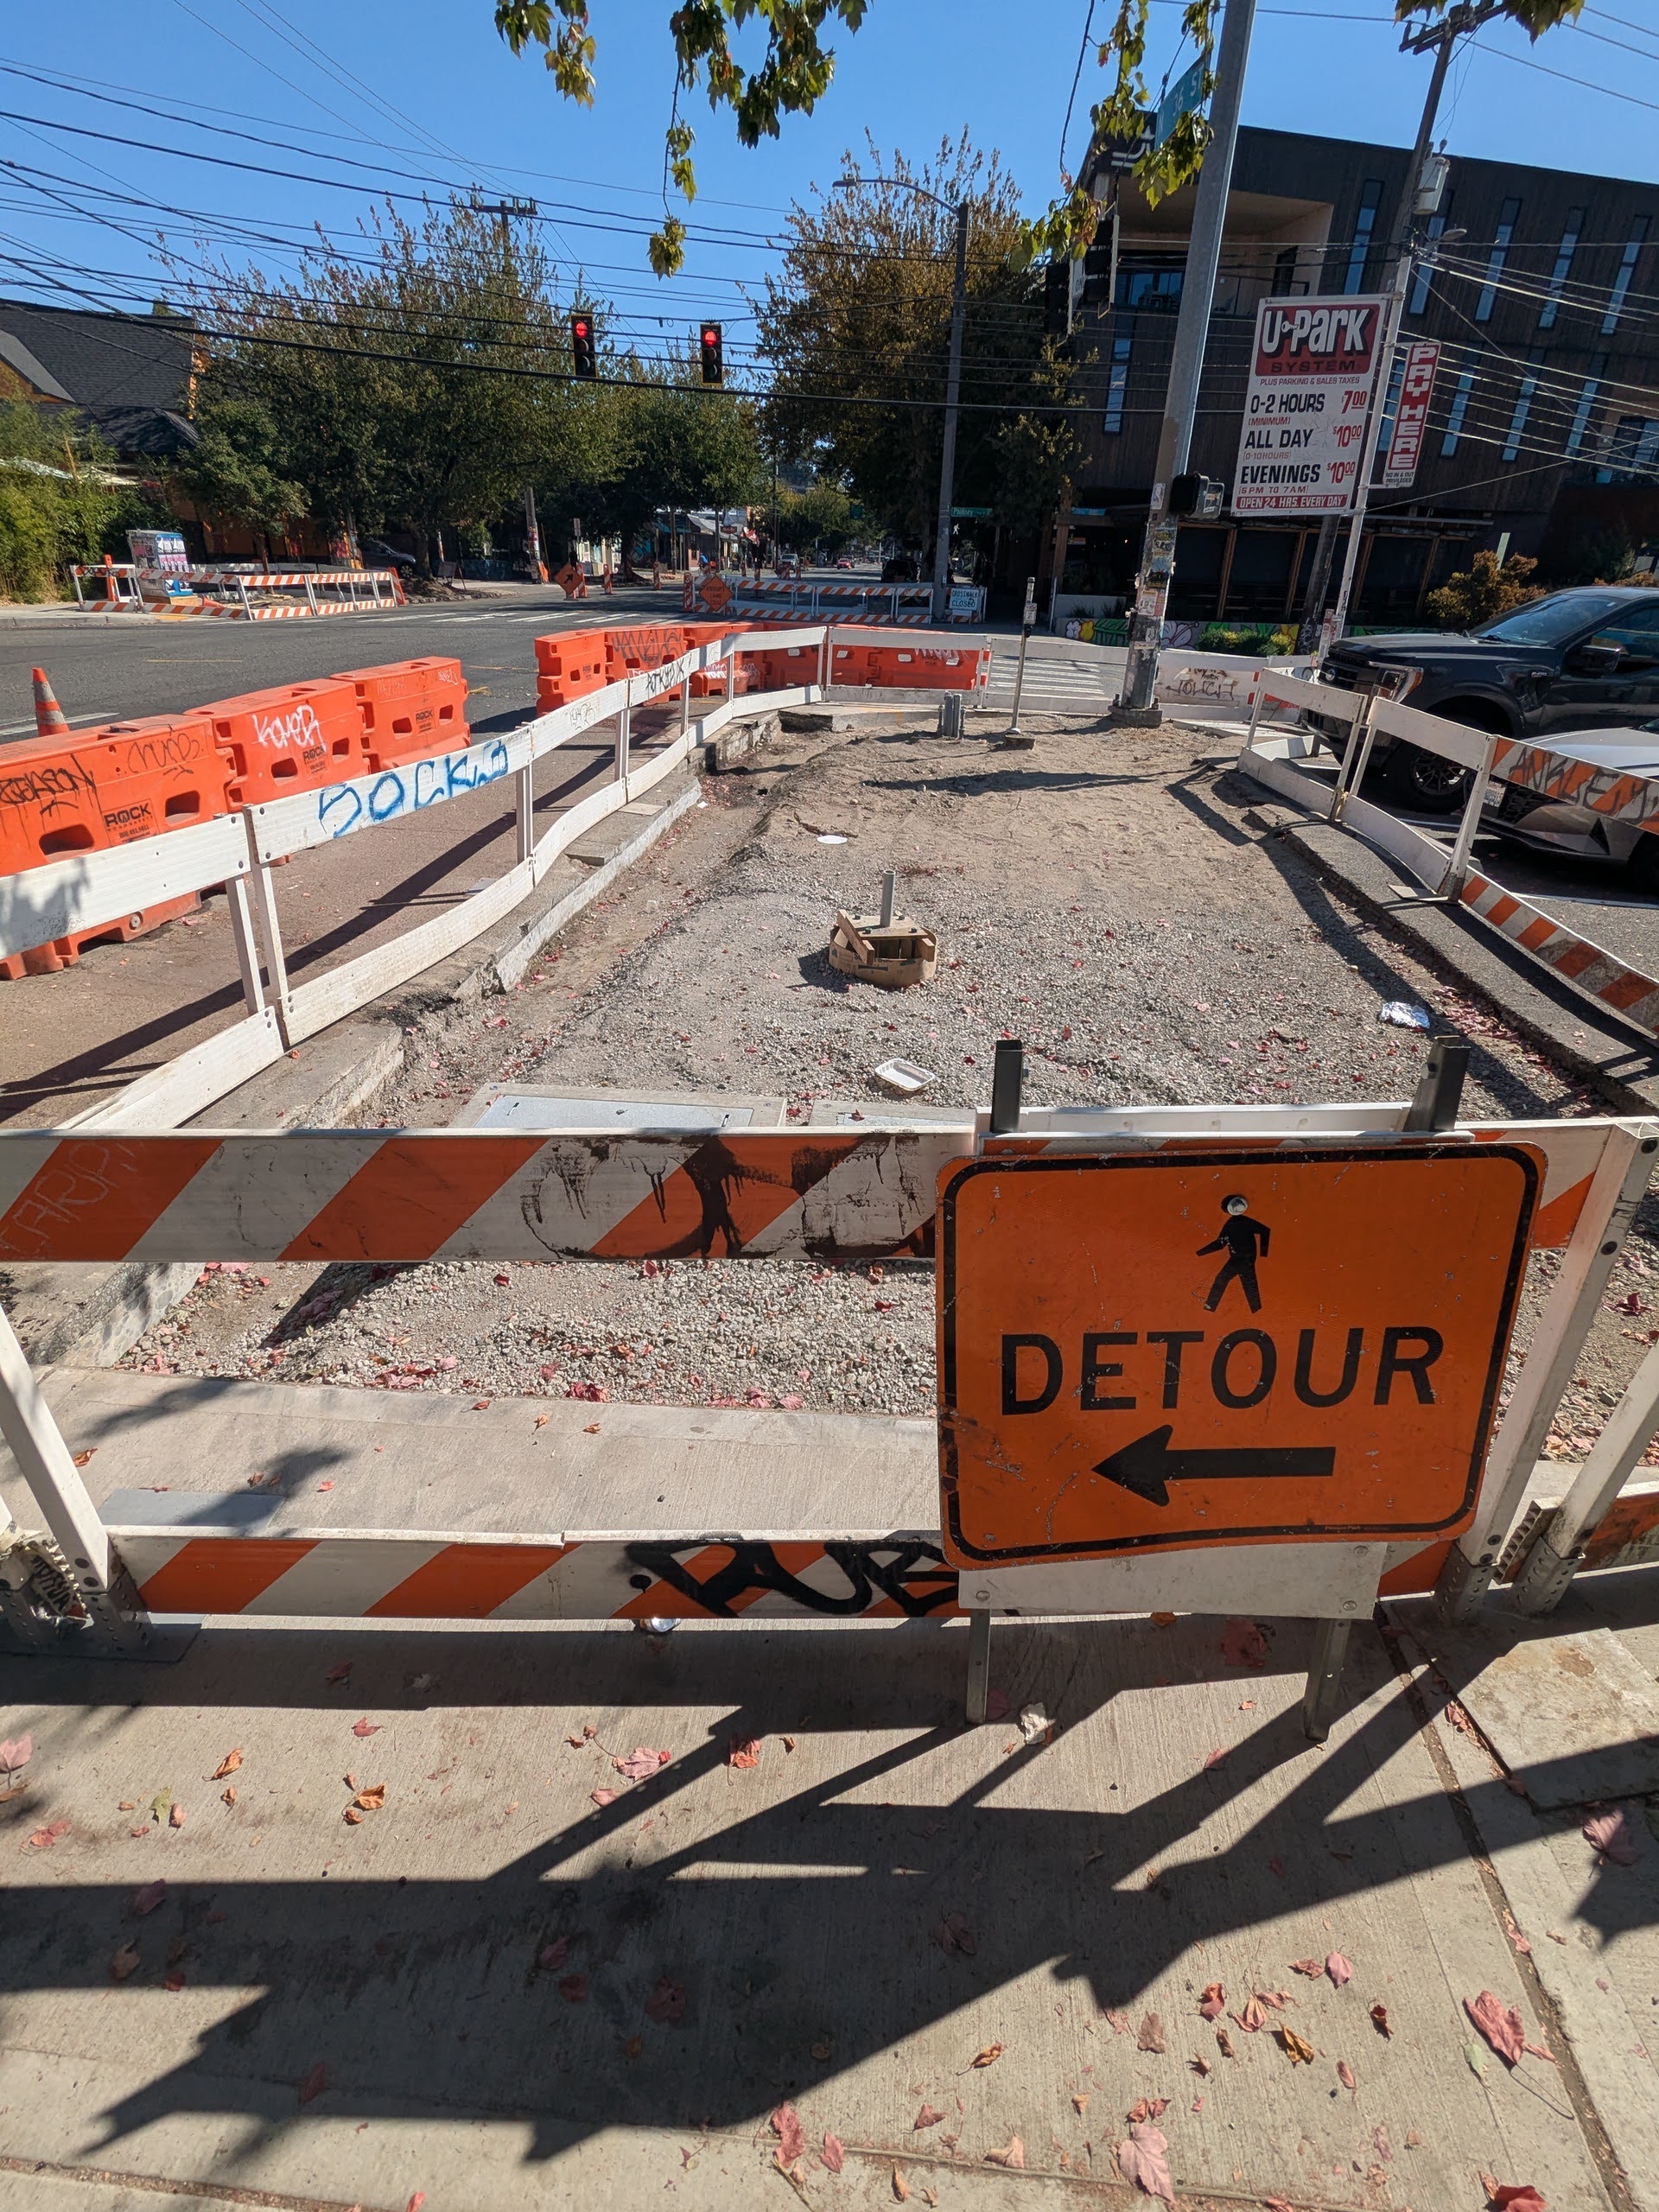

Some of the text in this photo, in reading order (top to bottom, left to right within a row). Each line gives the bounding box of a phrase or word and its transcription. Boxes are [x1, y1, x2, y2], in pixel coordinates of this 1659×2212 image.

[1271, 359, 1356, 373] SYSTEM
[1407, 346, 1436, 397] PAY
[1310, 377, 1314, 385] &
[1339, 376, 1360, 385] TAXES
[1250, 394, 1275, 414] 0-2
[1278, 393, 1325, 413] HOURS
[1244, 430, 1274, 449] ALL
[1279, 429, 1314, 448] DAY
[1390, 404, 1425, 468] HERE
[1240, 464, 1321, 484] EVENINGS
[1240, 498, 1262, 508] OPEN
[1264, 497, 1276, 507] 24
[1300, 496, 1325, 507] EVERY
[1326, 496, 1343, 506] DAY
[951, 599, 976, 607] CLOSED
[416, 709, 434, 723] ROCK
[104, 803, 152, 827] ROCK
[1001, 1326, 1445, 1415] DETOUR
